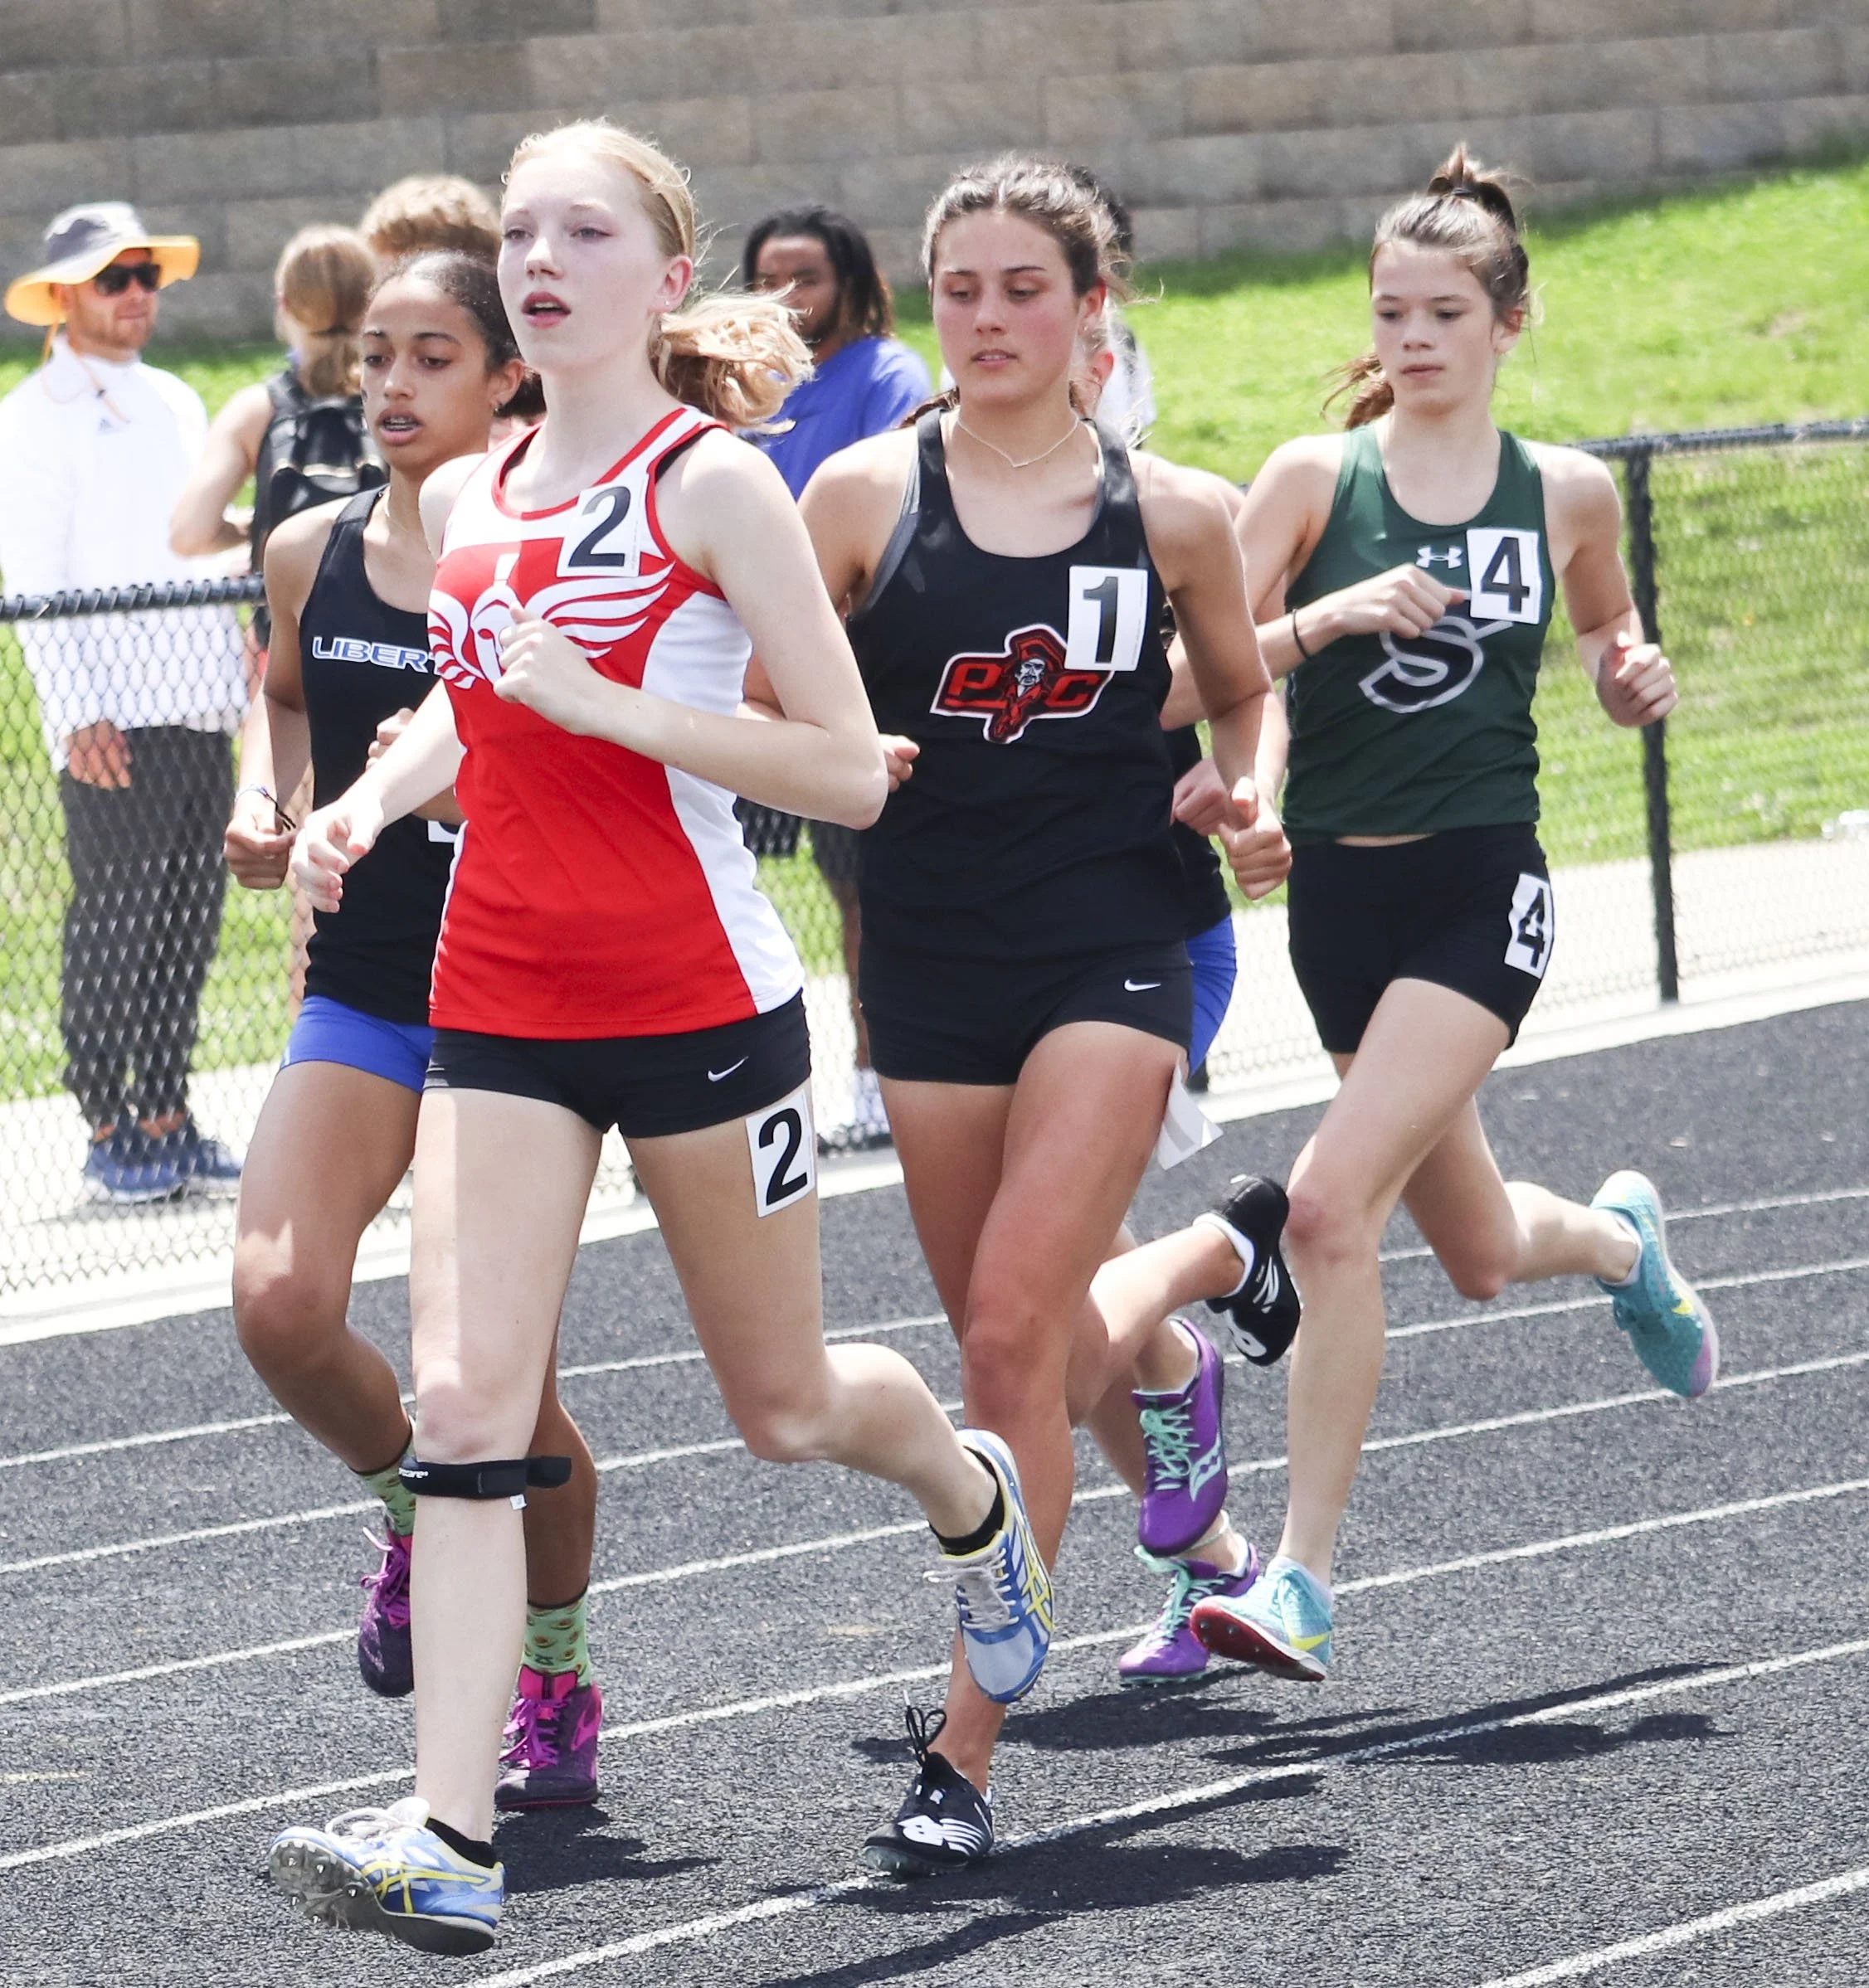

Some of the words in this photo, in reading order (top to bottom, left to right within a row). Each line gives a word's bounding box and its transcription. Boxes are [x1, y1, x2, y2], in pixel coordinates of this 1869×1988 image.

[567, 486, 632, 567] 2
[1480, 536, 1531, 614] 4
[1083, 576, 1119, 664] 1
[1516, 887, 1545, 970] 4
[758, 1107, 808, 1207] 2
